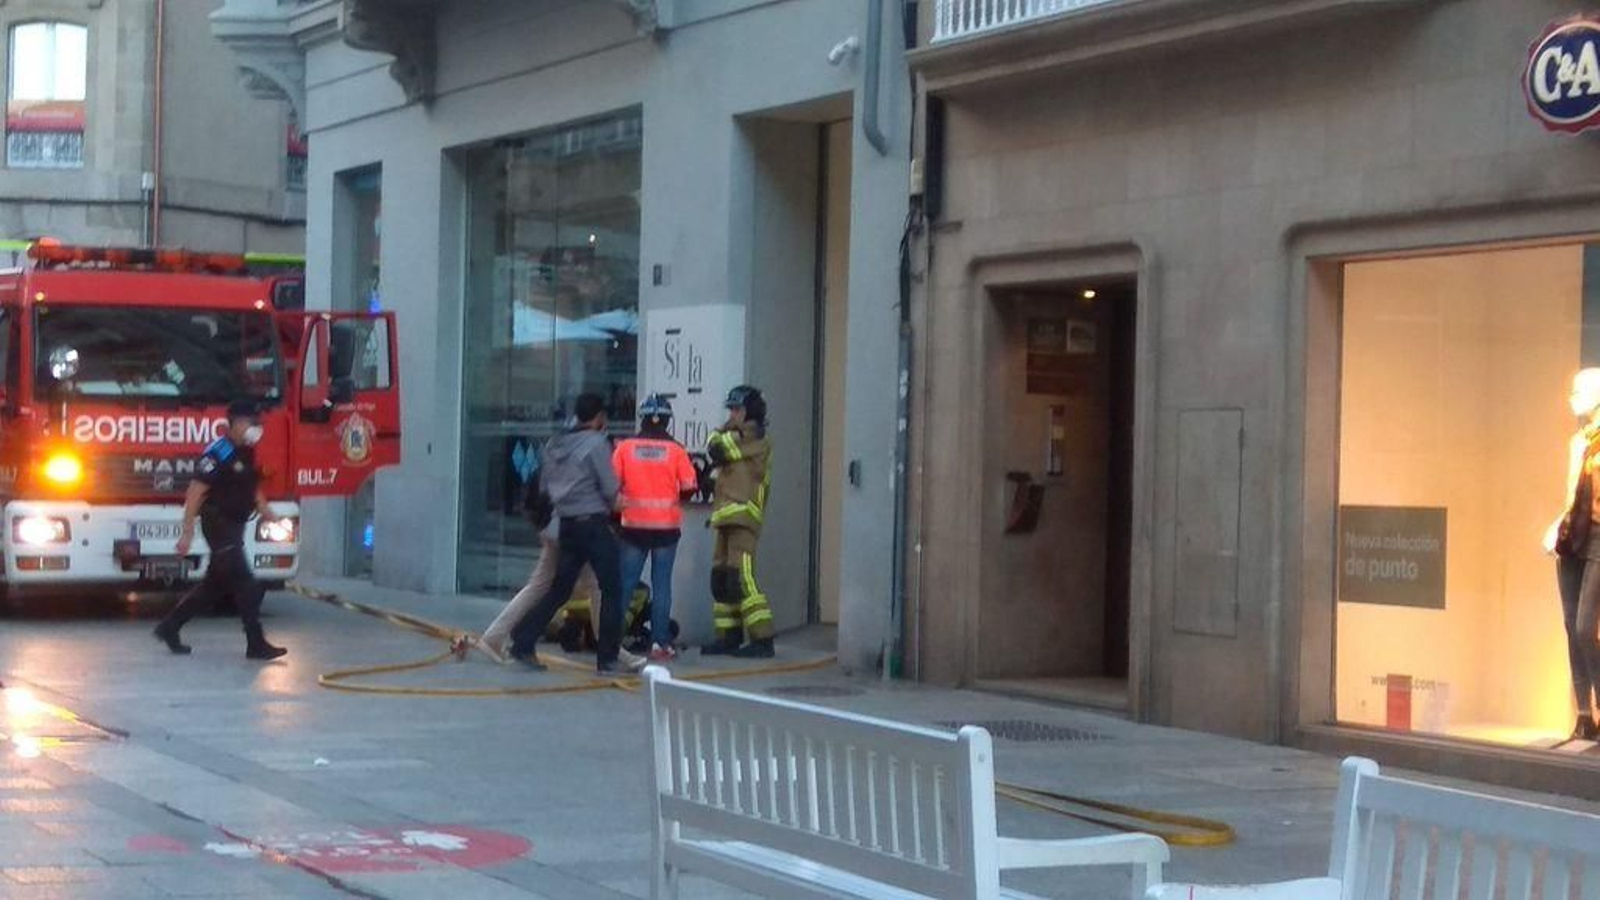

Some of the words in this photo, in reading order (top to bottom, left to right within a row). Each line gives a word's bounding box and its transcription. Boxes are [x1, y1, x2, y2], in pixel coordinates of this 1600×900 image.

[1534, 40, 1600, 103] C&A
[664, 338, 680, 380] Si
[688, 343, 702, 385] la
[684, 407, 709, 450] rio
[133, 459, 195, 473] MAN
[298, 467, 338, 486] BUL.7
[1345, 532, 1381, 550] Nueva
[1345, 553, 1365, 576] de
[1368, 557, 1418, 582] punto
